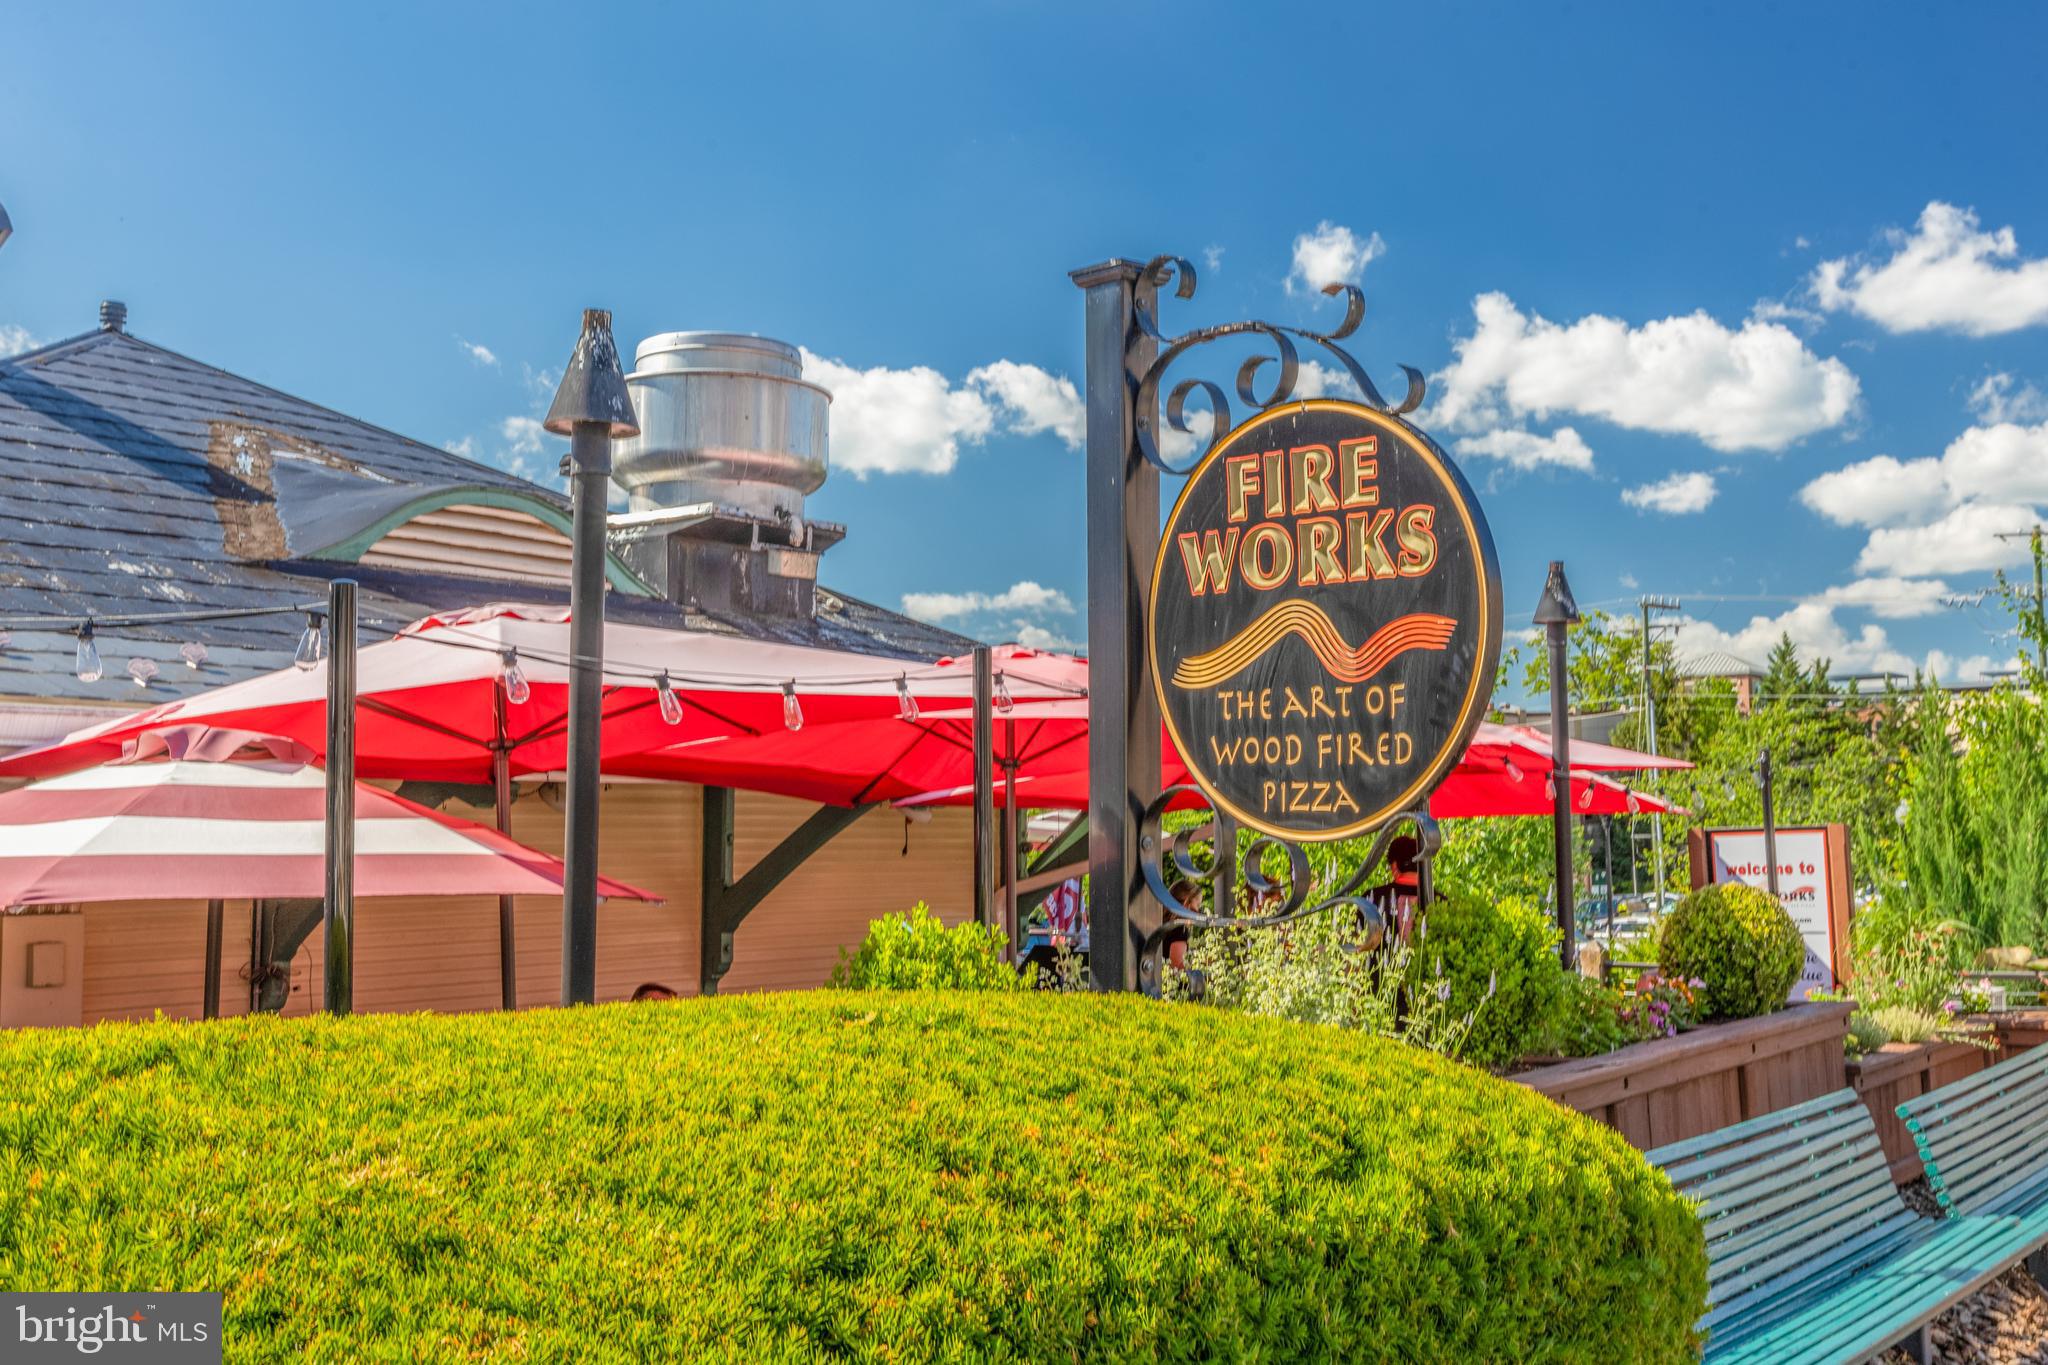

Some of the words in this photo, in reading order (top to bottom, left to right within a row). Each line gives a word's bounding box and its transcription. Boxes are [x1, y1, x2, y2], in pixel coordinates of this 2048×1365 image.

[1226, 435, 1379, 523] FIRE
[1179, 505, 1438, 596] WORKS
[1218, 688, 1272, 720] THE
[1282, 685, 1355, 718] ART
[1366, 683, 1406, 715] OF
[1211, 734, 1302, 766] WOOD
[1317, 732, 1412, 768] FIRED
[1263, 780, 1360, 814] PIZZA
[1799, 861, 1815, 875] to
